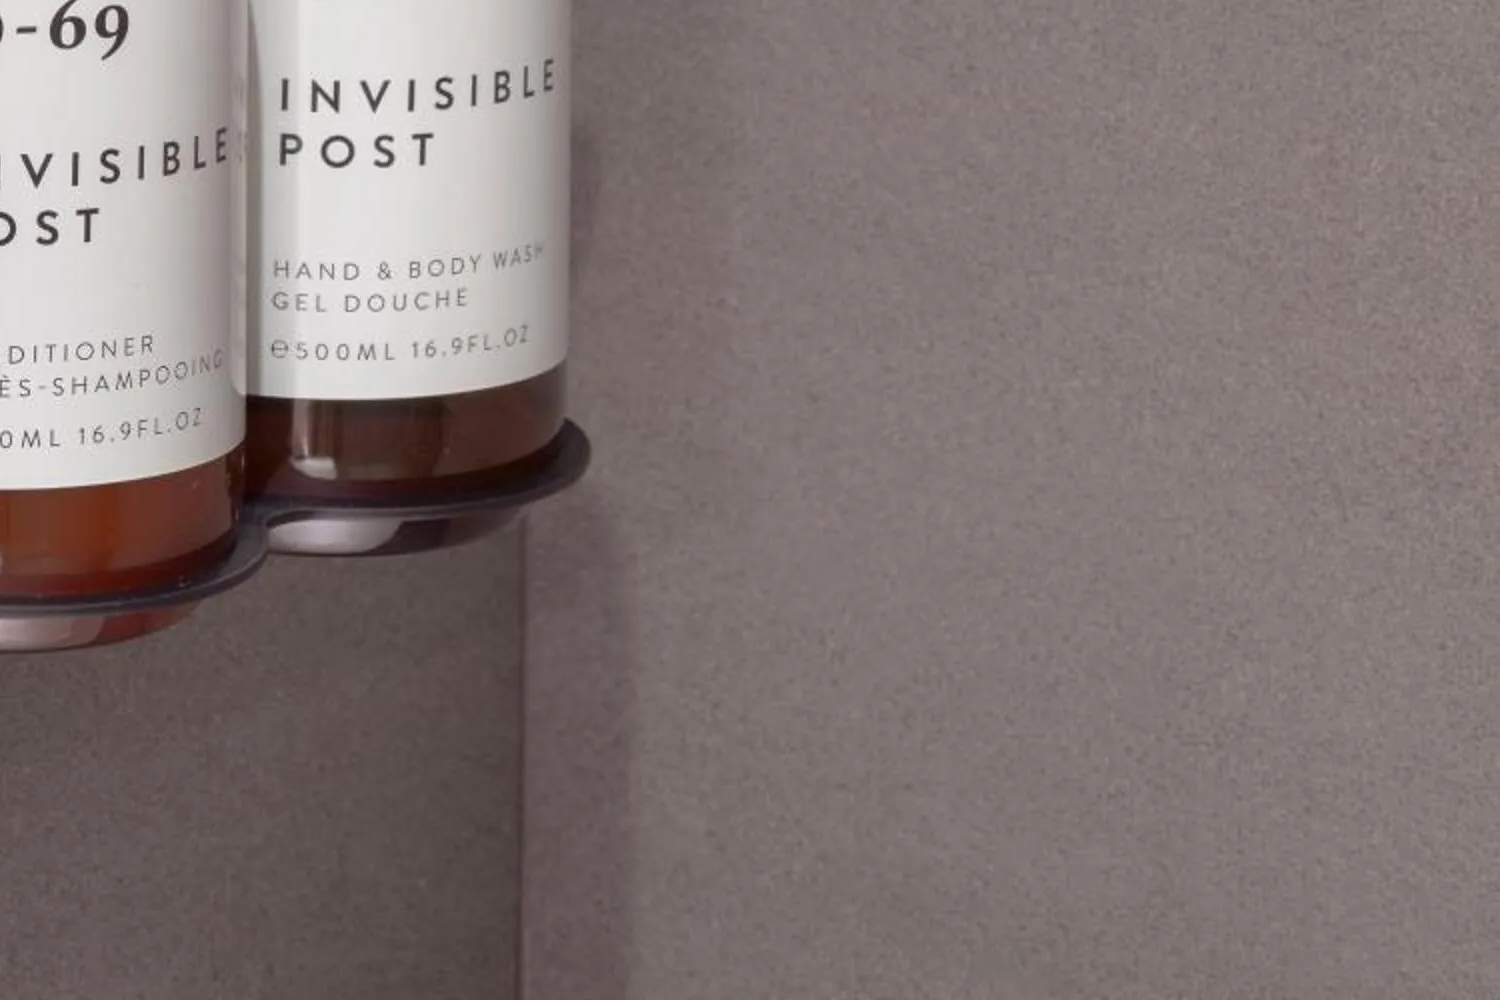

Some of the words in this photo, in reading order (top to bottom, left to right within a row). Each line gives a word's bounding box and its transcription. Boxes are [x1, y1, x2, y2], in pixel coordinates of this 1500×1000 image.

[280, 59, 554, 114] INVISIBLE
[279, 132, 435, 169] POST
[273, 259, 361, 281] HAND
[376, 260, 393, 281] &
[408, 254, 481, 280] BODY
[270, 290, 328, 313] GEL
[343, 286, 467, 313] DOUCHE
[411, 324, 529, 359] 16.9FL.OZ
[77, 407, 201, 446] 16.9FL.OZ
